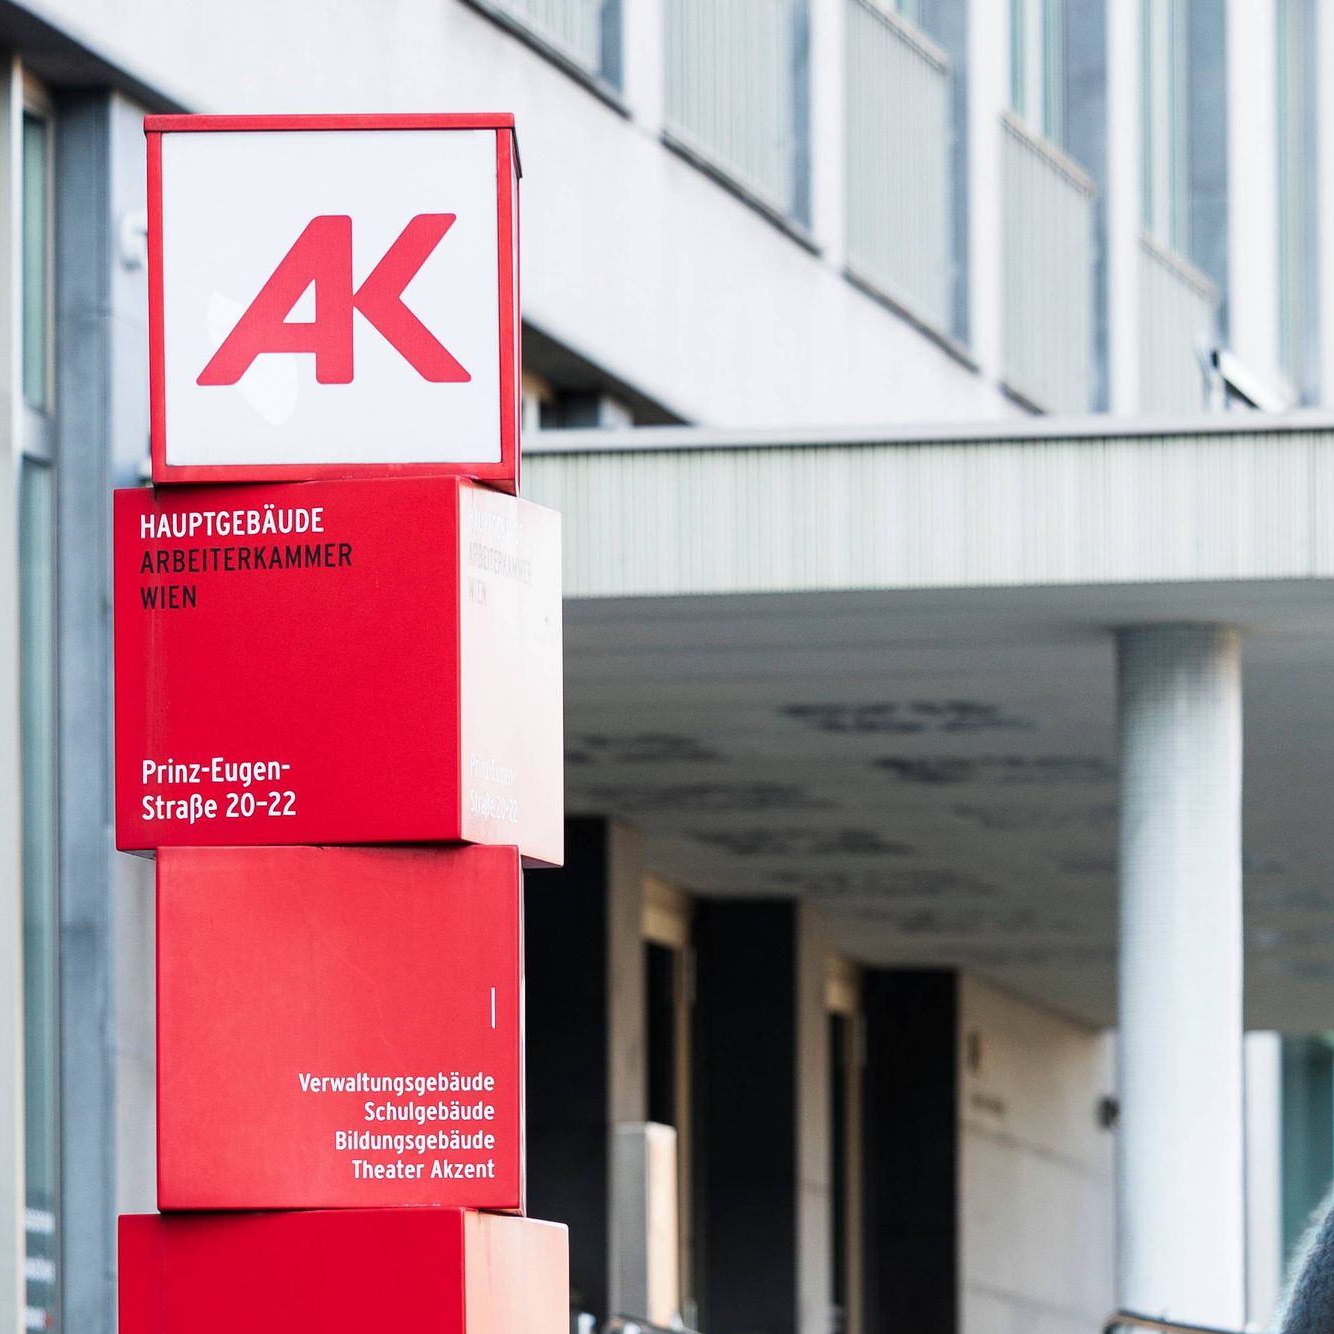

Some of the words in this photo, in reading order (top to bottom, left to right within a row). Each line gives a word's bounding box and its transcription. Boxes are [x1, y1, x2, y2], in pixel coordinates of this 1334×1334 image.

[196, 213, 472, 386] AK
[140, 503, 324, 539] HAUPTGEBÄUDE
[140, 543, 352, 574] ARBEITERKAMMER
[140, 585, 196, 610] WIEN
[142, 757, 291, 788] Prinz-Eugen-
[141, 794, 218, 825] Straße
[298, 1071, 495, 1097] Verwaltungsgebäude
[364, 1100, 495, 1126] Schulgebäude
[335, 1129, 496, 1155] Bildungsgebäude
[351, 1159, 425, 1180] Theater
[430, 1158, 495, 1180] Akzent
